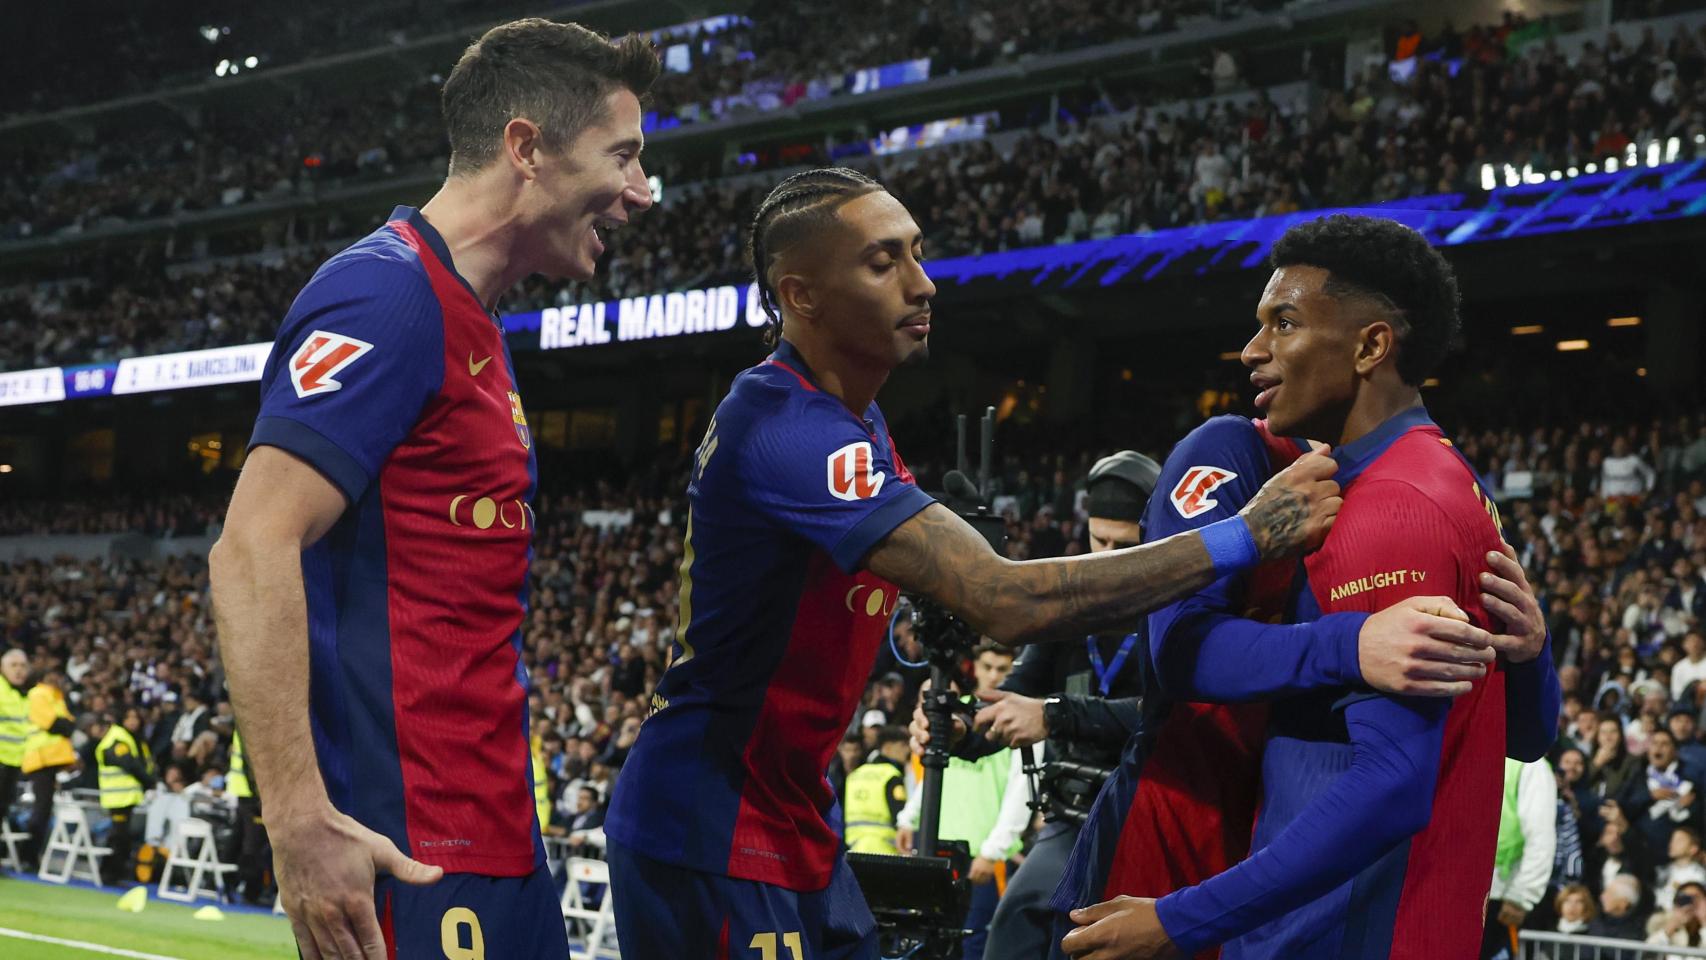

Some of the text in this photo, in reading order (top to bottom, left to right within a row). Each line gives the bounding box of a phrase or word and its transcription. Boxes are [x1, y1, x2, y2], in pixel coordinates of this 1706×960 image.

[540, 302, 611, 350] REAL
[618, 286, 739, 341] MADRID
[1330, 569, 1426, 602] AMBILIGHT tv
[440, 906, 486, 960] 9
